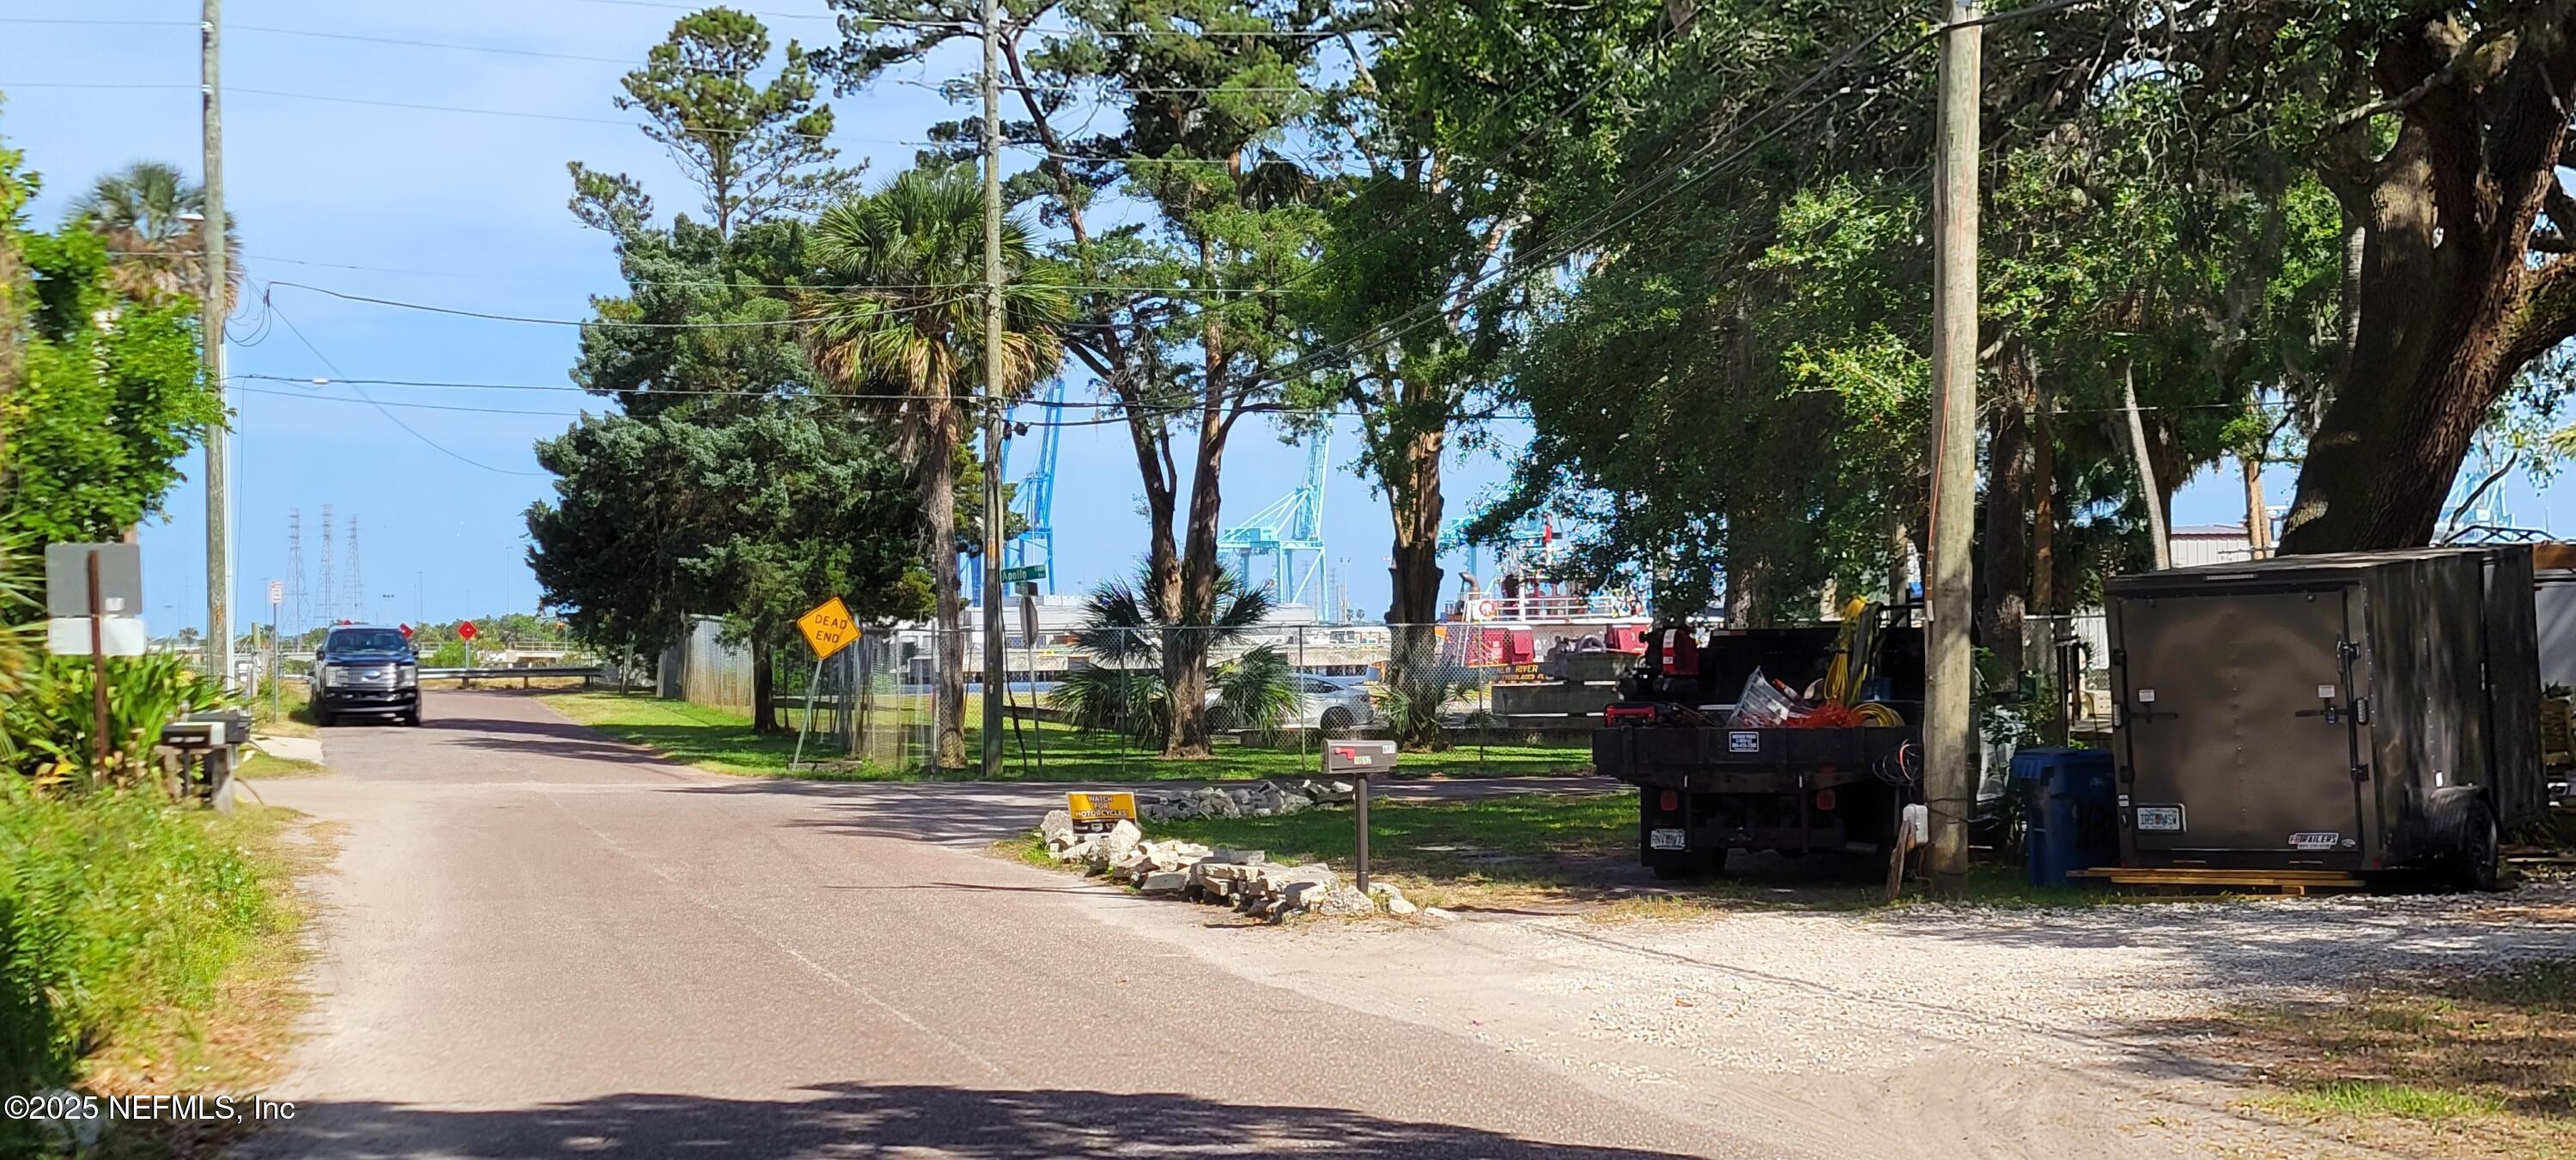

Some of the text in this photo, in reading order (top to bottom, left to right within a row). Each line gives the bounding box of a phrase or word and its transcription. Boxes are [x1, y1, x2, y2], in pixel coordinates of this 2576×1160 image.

[1002, 568, 1027, 581] Apollo
[815, 614, 848, 629] DEAD
[815, 630, 840, 643] END
[1516, 665, 1539, 673] RIVER
